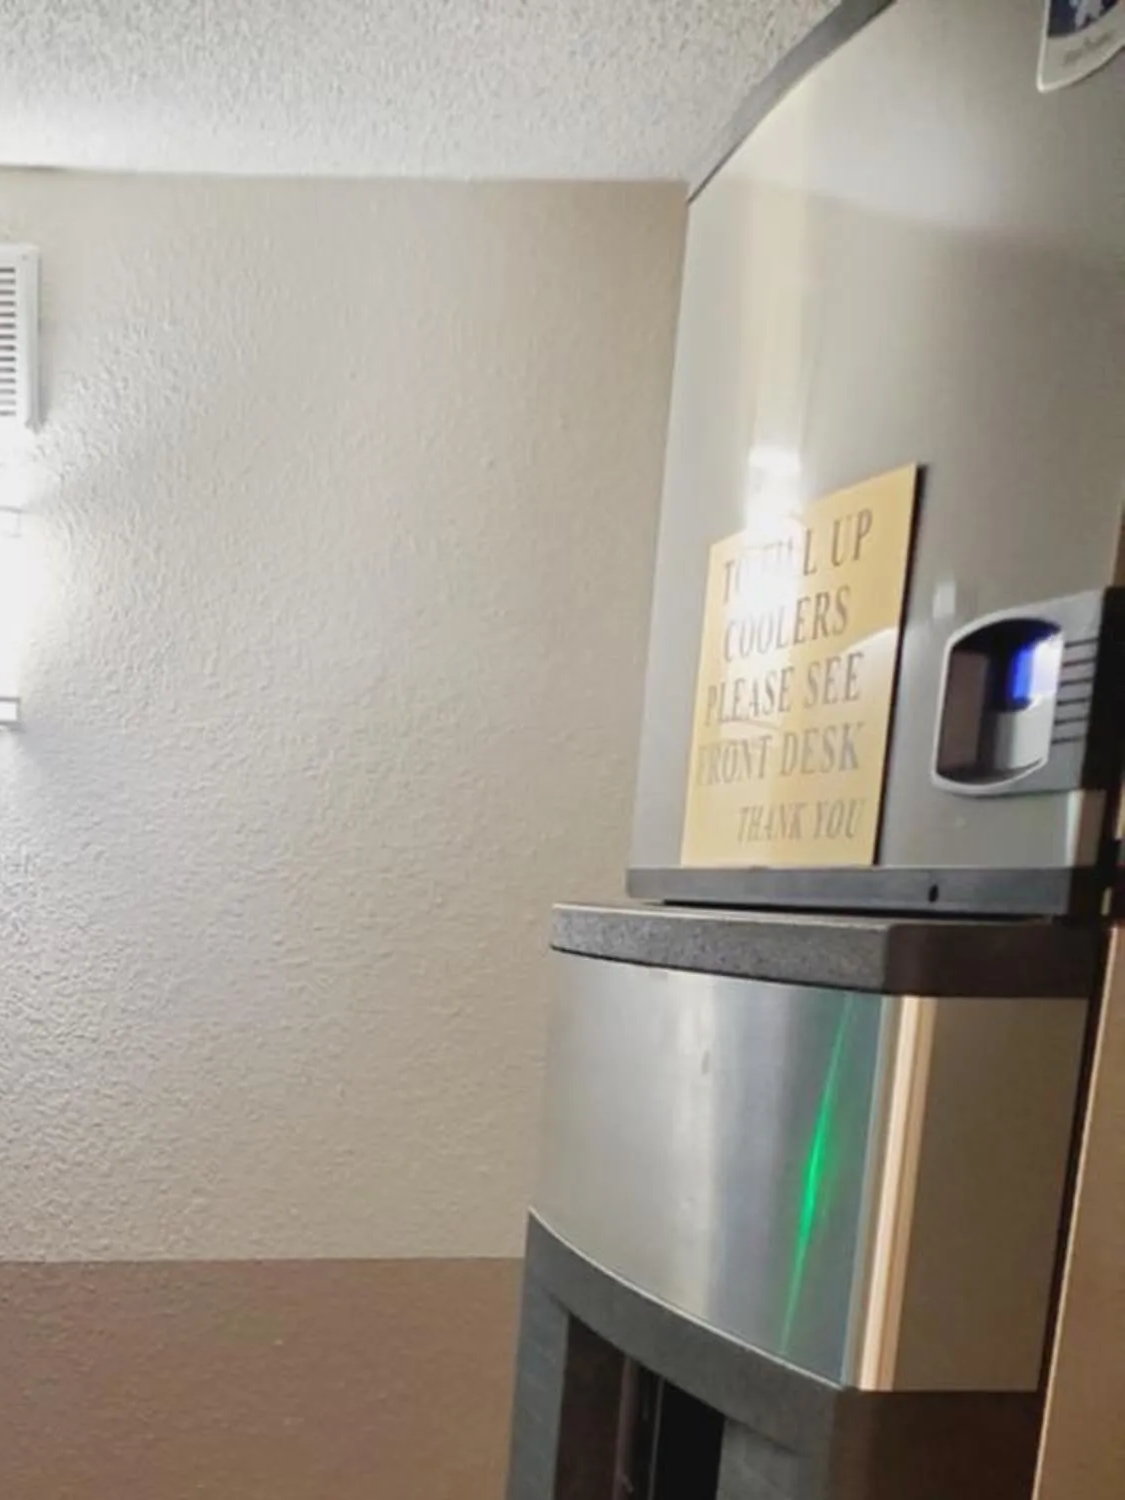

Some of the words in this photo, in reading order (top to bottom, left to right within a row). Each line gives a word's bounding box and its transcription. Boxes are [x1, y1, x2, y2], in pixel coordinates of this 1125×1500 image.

[831, 508, 873, 568] UP
[723, 584, 851, 664] COOLERS
[704, 665, 796, 728] PLEASE
[803, 652, 865, 709] SEE
[695, 734, 773, 785] FRONT
[779, 720, 866, 778] DESK
[737, 801, 809, 843] THANK
[812, 798, 868, 841] YOU
